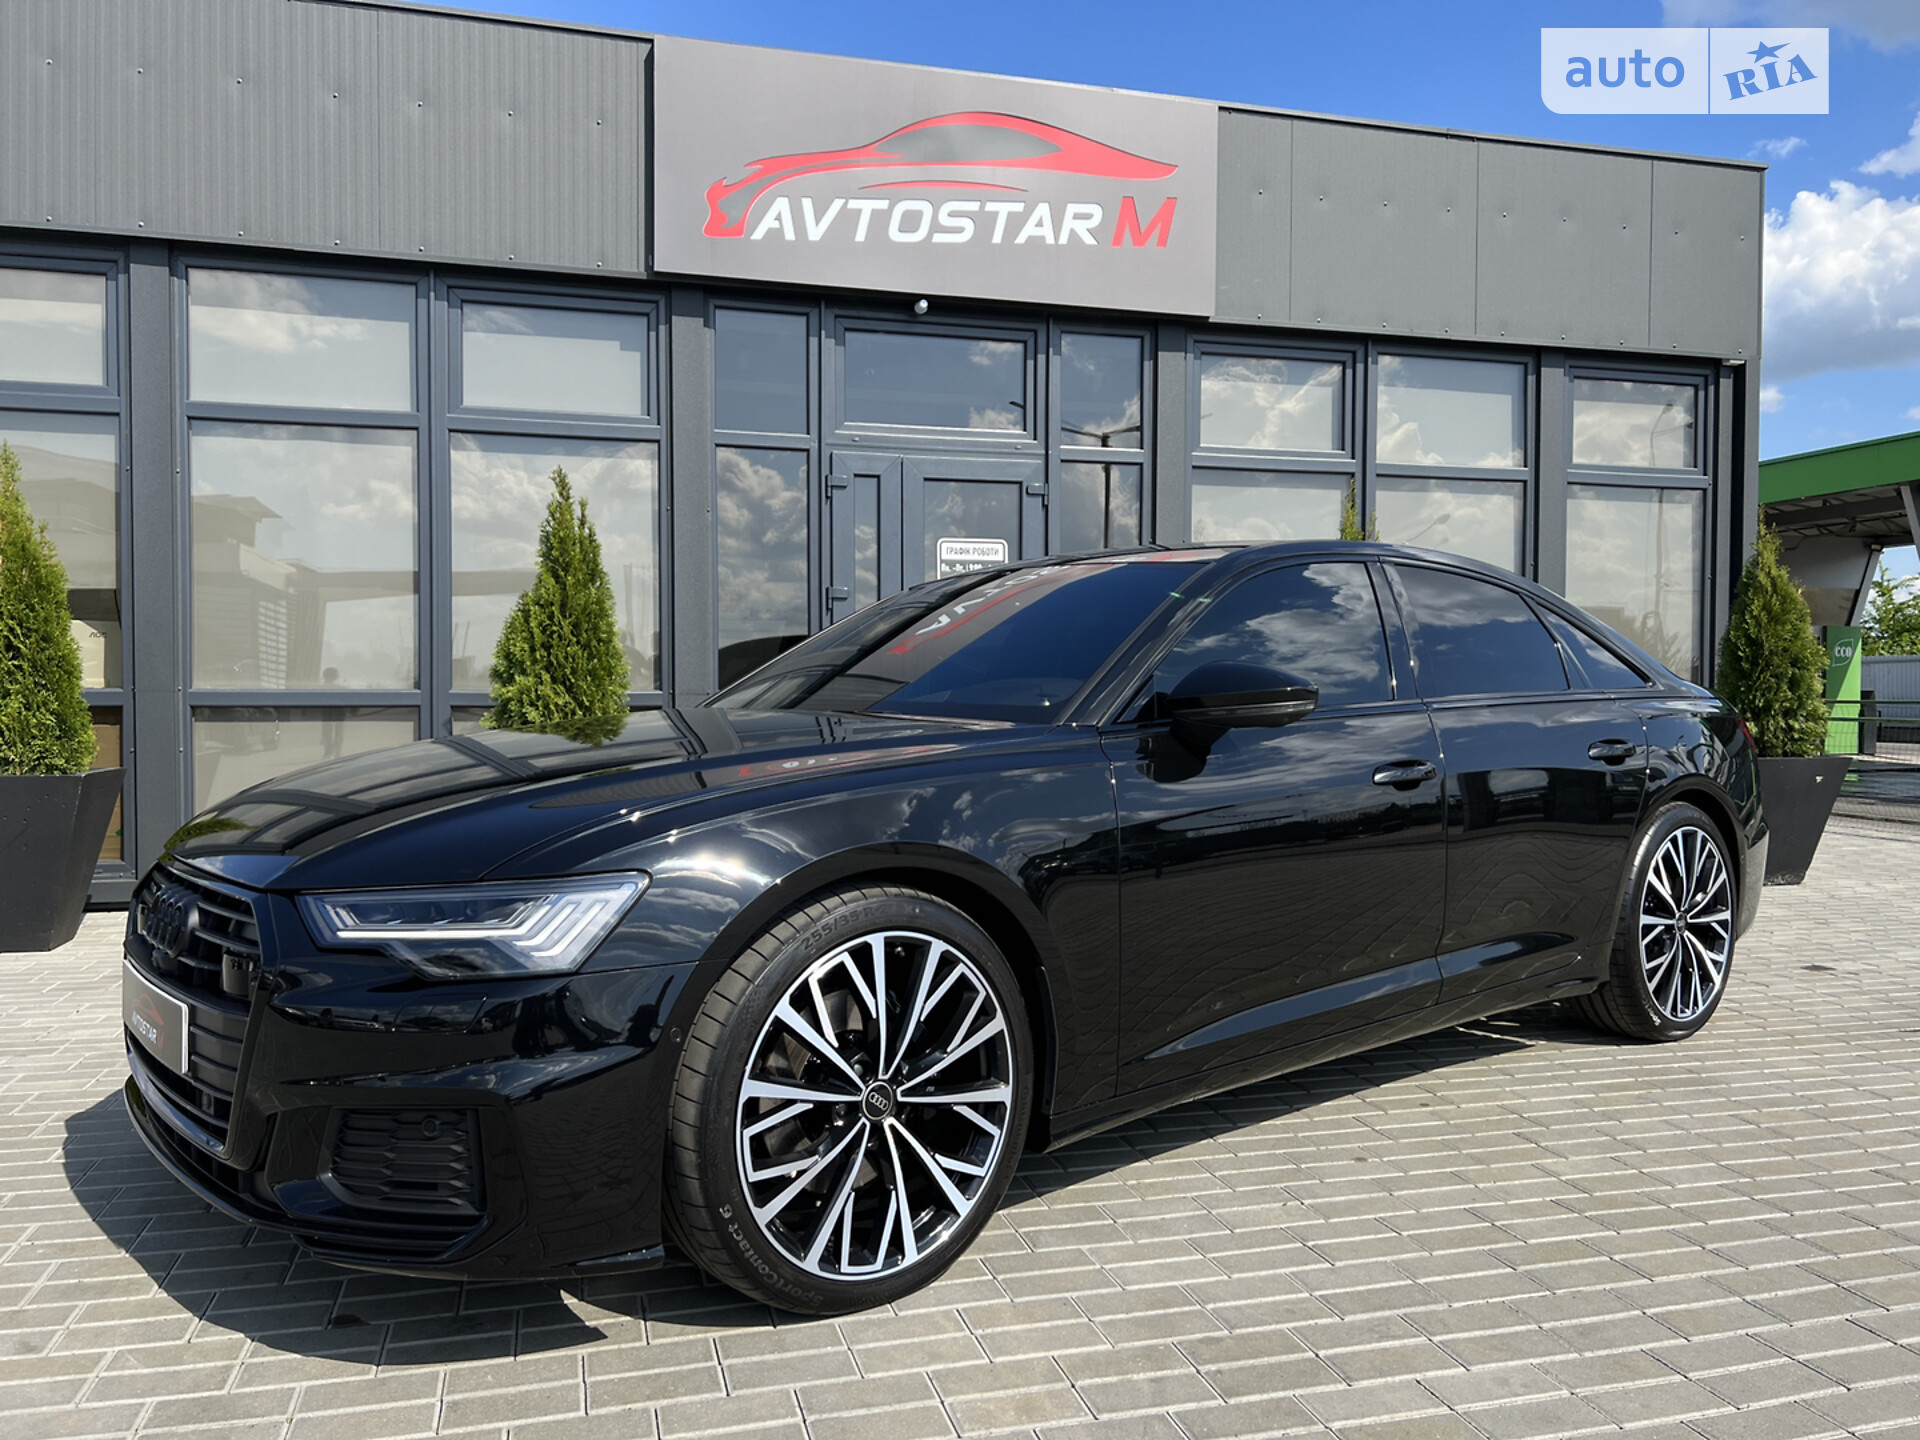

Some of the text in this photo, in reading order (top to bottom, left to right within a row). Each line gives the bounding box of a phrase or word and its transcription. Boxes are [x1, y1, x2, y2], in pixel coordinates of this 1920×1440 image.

[750, 195, 1178, 248] AVTOSTAR M
[946, 546, 999, 557] ГРАФІК РОБОТИ
[800, 910, 860, 951] 255/35
[728, 1221, 824, 1307] SportContact
